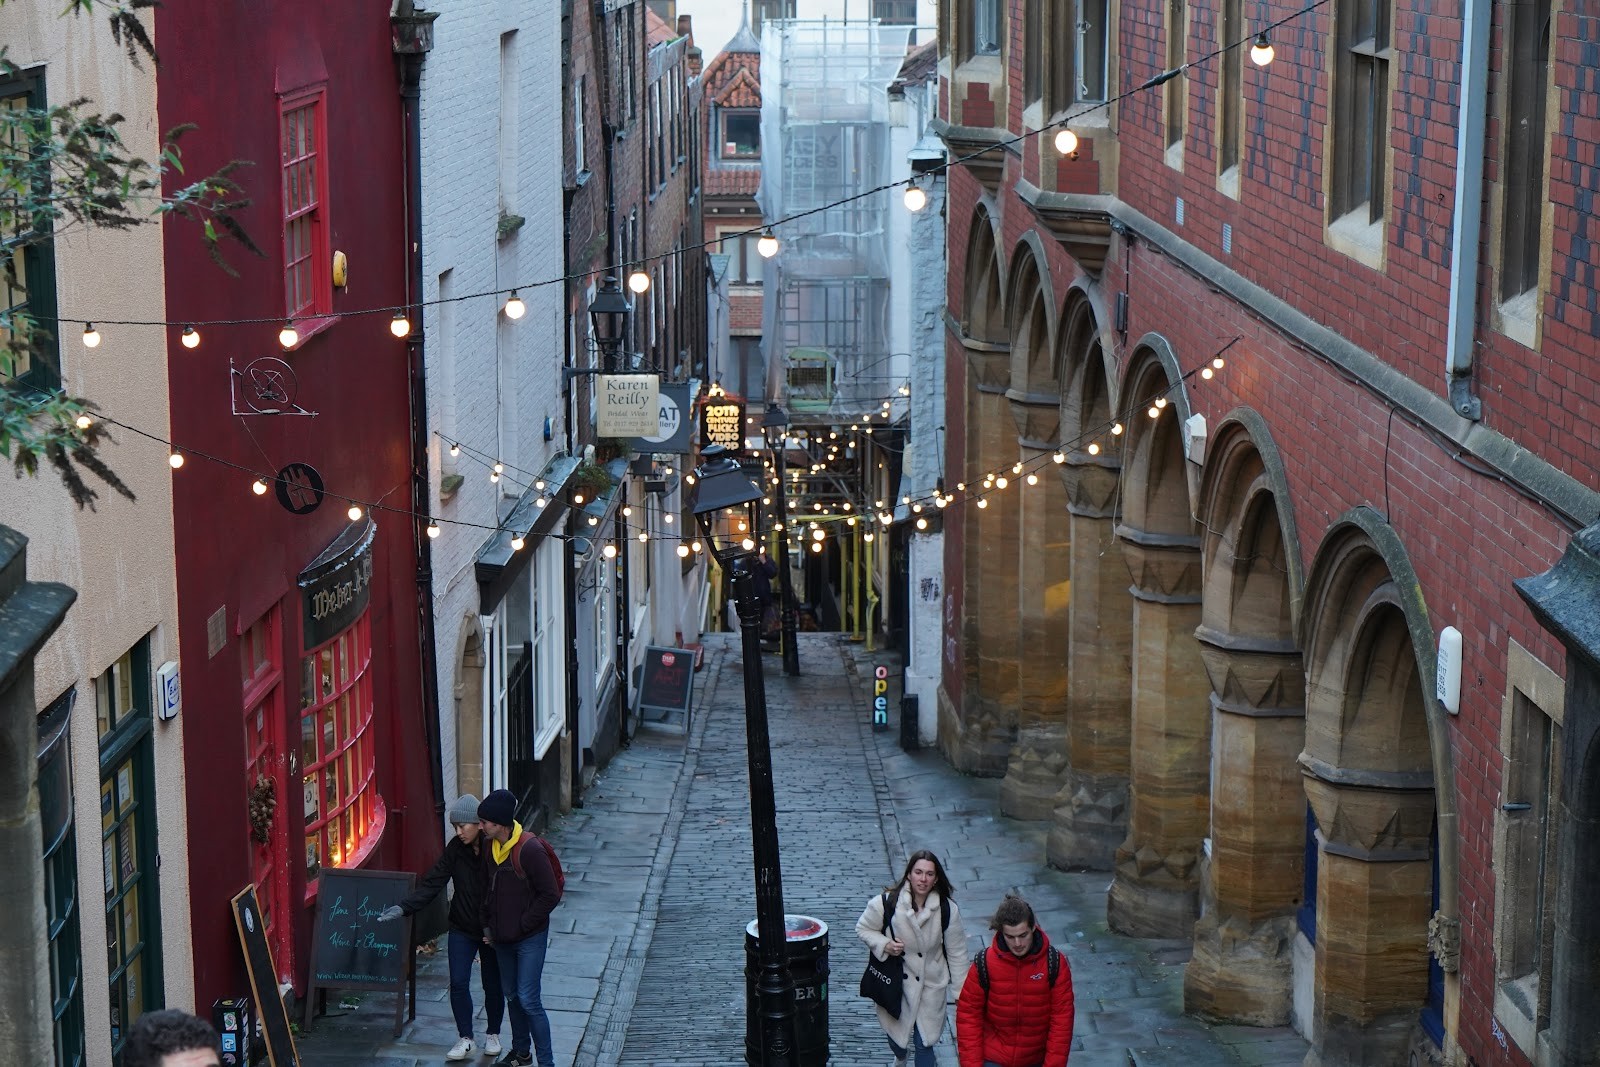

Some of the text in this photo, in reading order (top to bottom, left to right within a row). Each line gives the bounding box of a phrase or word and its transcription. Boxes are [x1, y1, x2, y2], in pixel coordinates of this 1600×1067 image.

[606, 379, 649, 391] Karen
[607, 391, 650, 410] Reilly
[705, 405, 740, 417] 20TH
[705, 416, 739, 424] CENTURY
[707, 423, 739, 433] FLICKS
[706, 432, 740, 442] VIDEO
[313, 581, 353, 620] Weber
[874, 662, 888, 724] open
